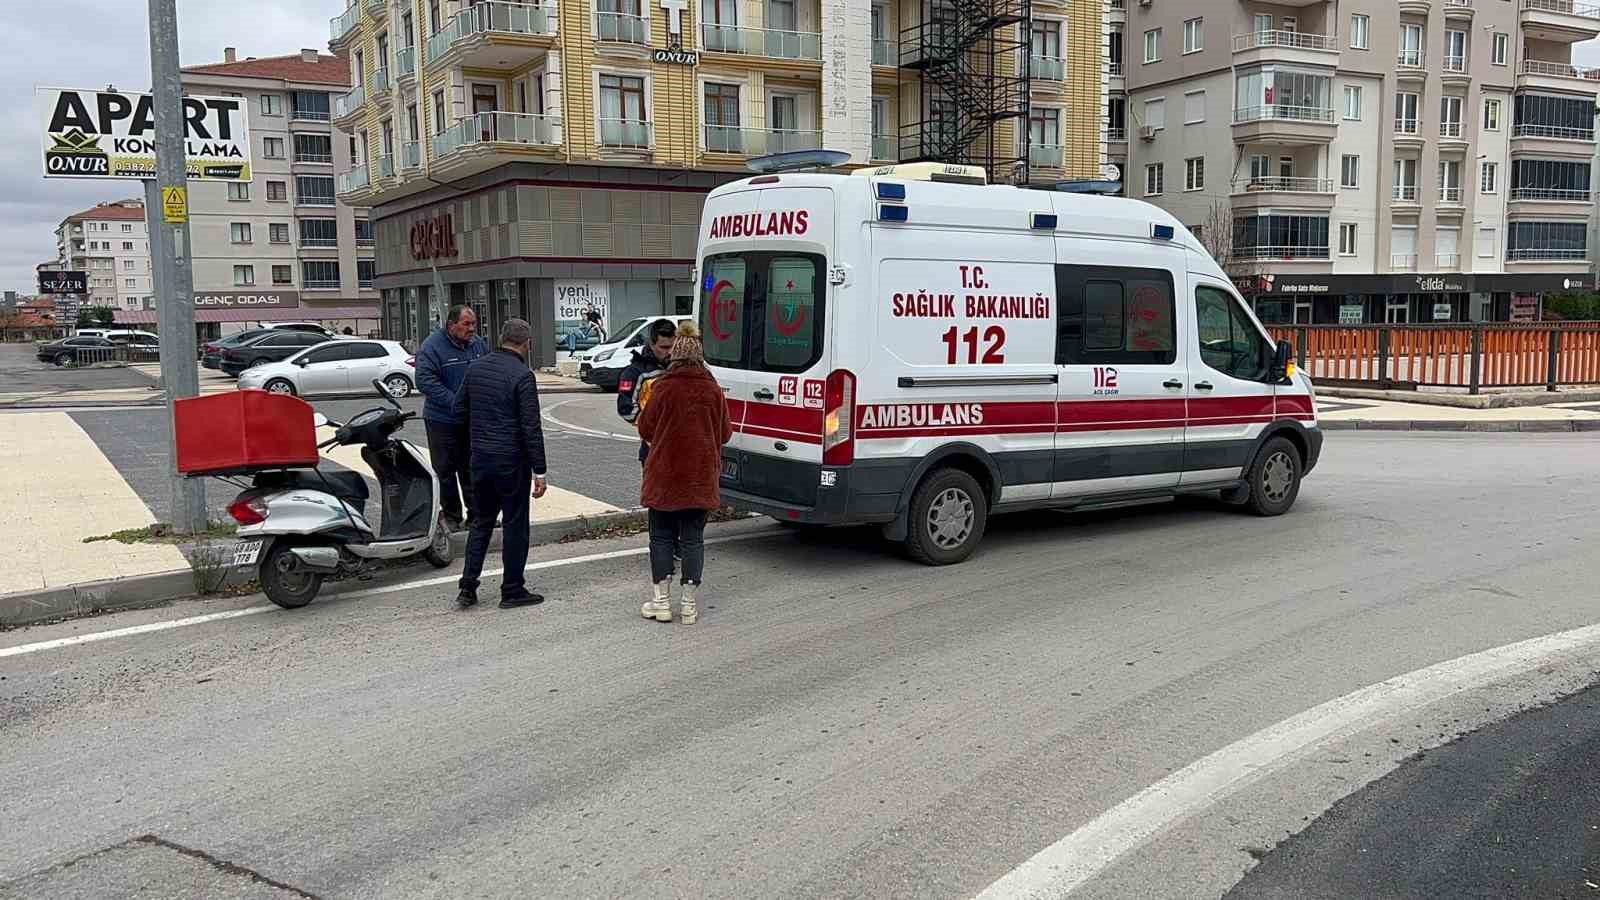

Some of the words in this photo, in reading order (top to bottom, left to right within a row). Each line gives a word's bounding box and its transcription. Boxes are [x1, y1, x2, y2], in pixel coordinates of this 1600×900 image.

[655, 51, 696, 64] ONUR
[114, 138, 243, 158] KONLAMA
[49, 156, 107, 172] ONUR
[709, 210, 809, 239] AMBULANS
[43, 281, 83, 289] SEZER
[959, 265, 989, 289] T.C.
[194, 296, 234, 306] GENÇ
[237, 295, 281, 304] ODASI
[558, 283, 590, 300] yeni
[892, 289, 956, 317] SAĞLIK
[965, 292, 1050, 319] BAKANLIĞI
[942, 325, 1006, 364] 112
[780, 379, 795, 393] 112
[1093, 367, 1118, 387] 112
[806, 382, 823, 397] 112
[860, 403, 985, 429] AMBULANS
